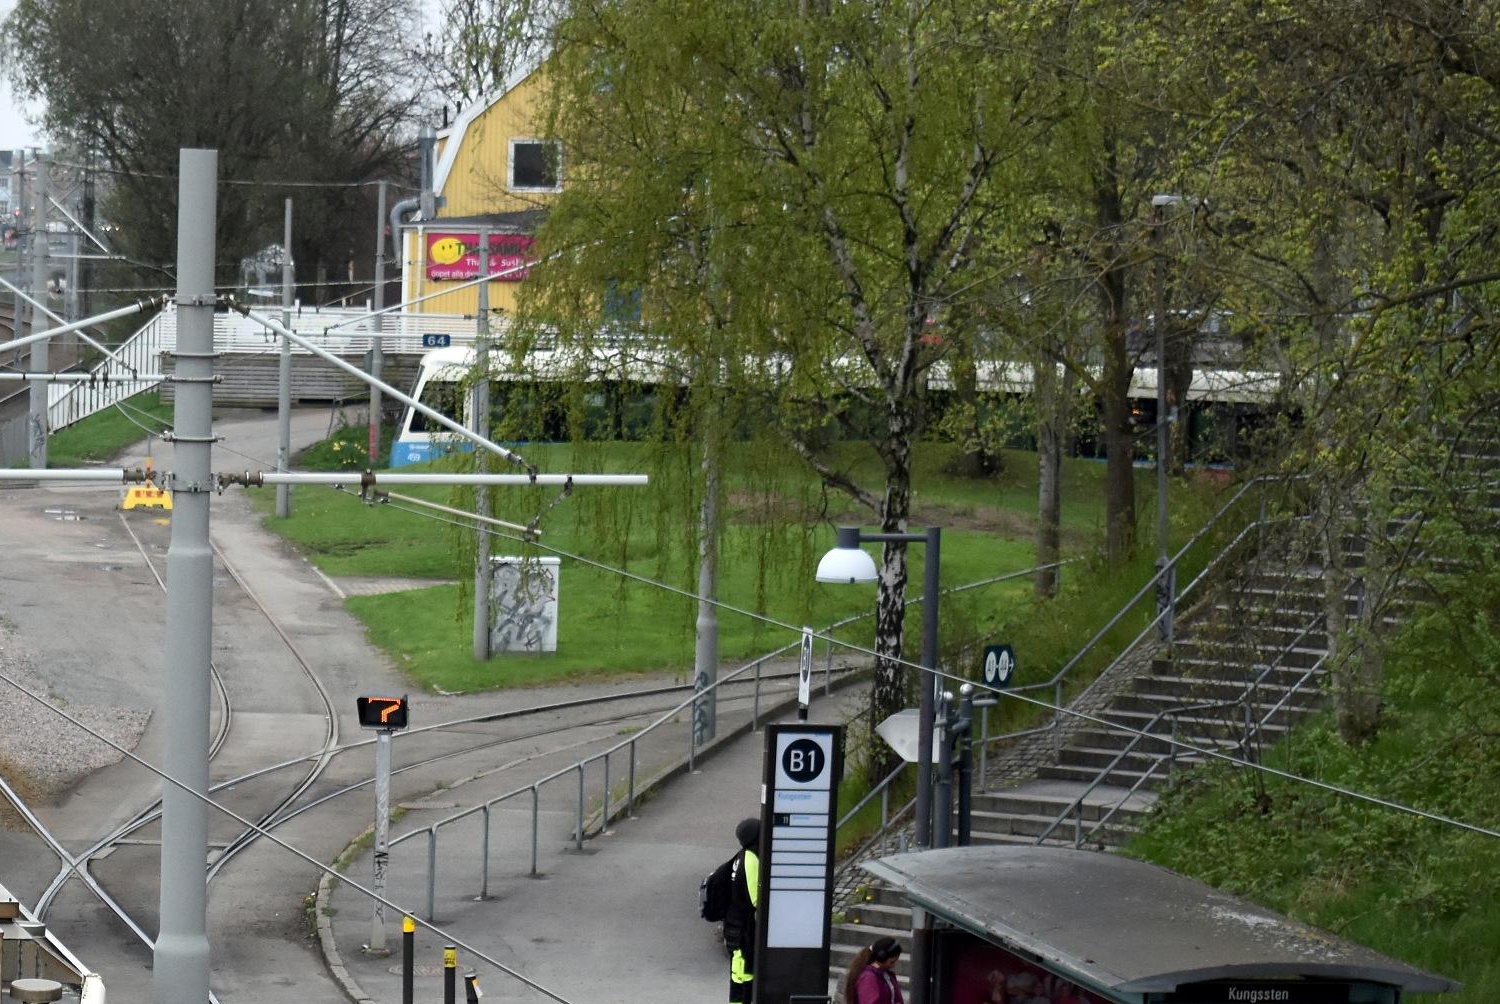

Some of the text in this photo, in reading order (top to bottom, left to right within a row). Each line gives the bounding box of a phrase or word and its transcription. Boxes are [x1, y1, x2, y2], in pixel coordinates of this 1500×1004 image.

[427, 336, 446, 346] 64
[790, 750, 816, 772] B1
[1228, 986, 1289, 1003] Kungssten
